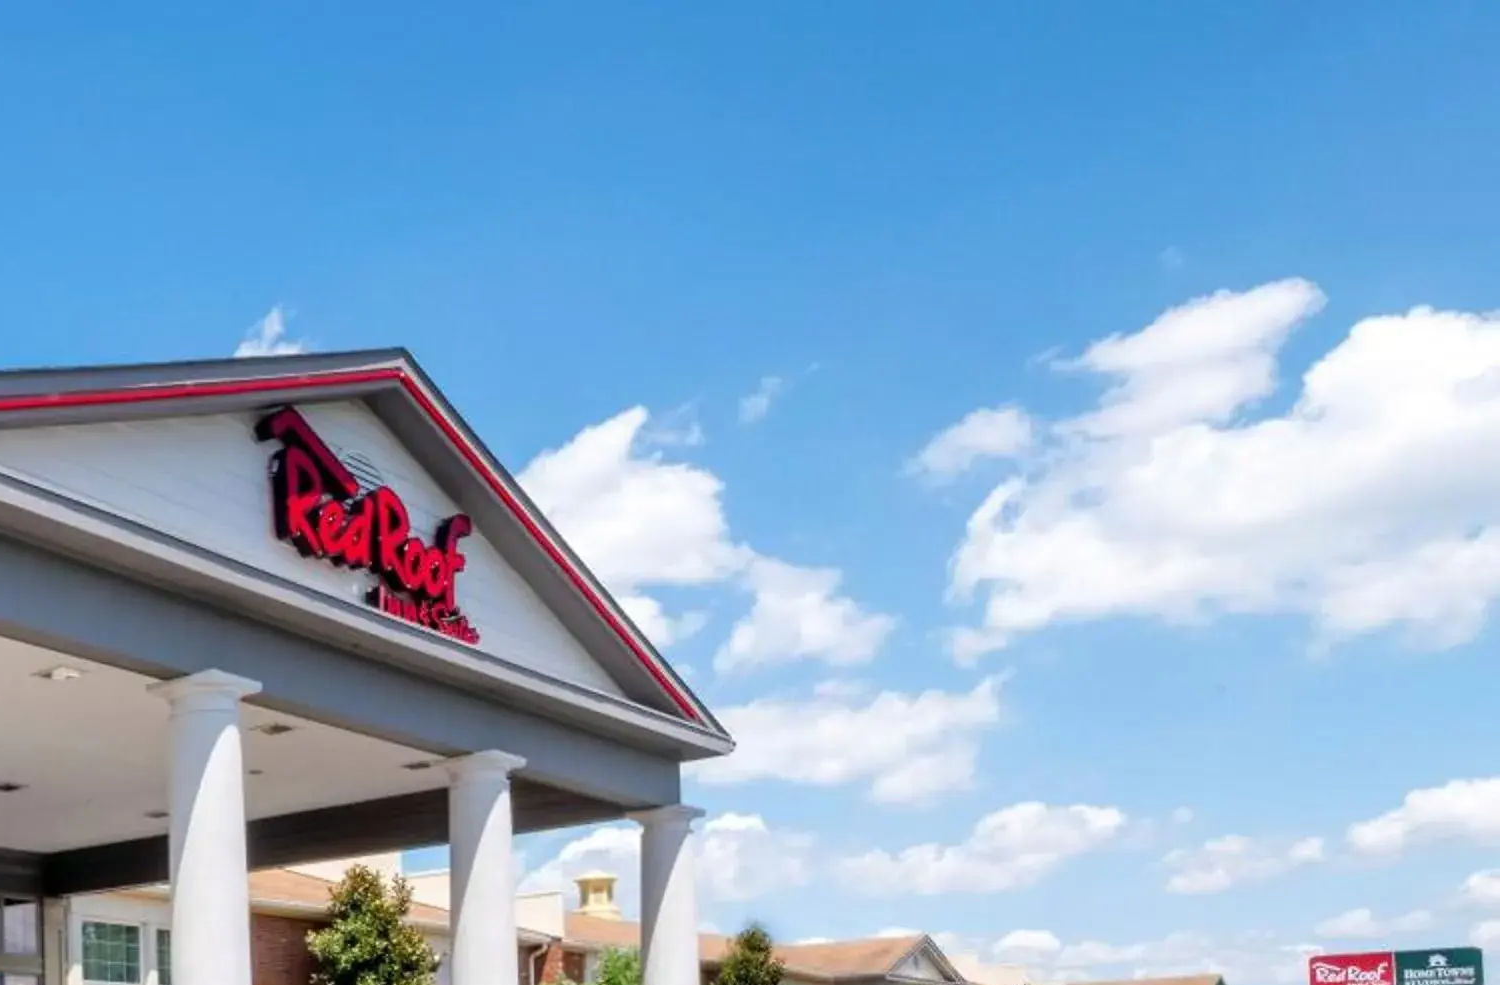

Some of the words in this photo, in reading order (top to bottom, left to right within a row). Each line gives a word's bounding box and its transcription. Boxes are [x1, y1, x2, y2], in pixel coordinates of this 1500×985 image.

[257, 405, 374, 568] Red
[377, 486, 472, 609] Roof
[1312, 962, 1346, 982] Red
[1347, 961, 1389, 982] Roof
